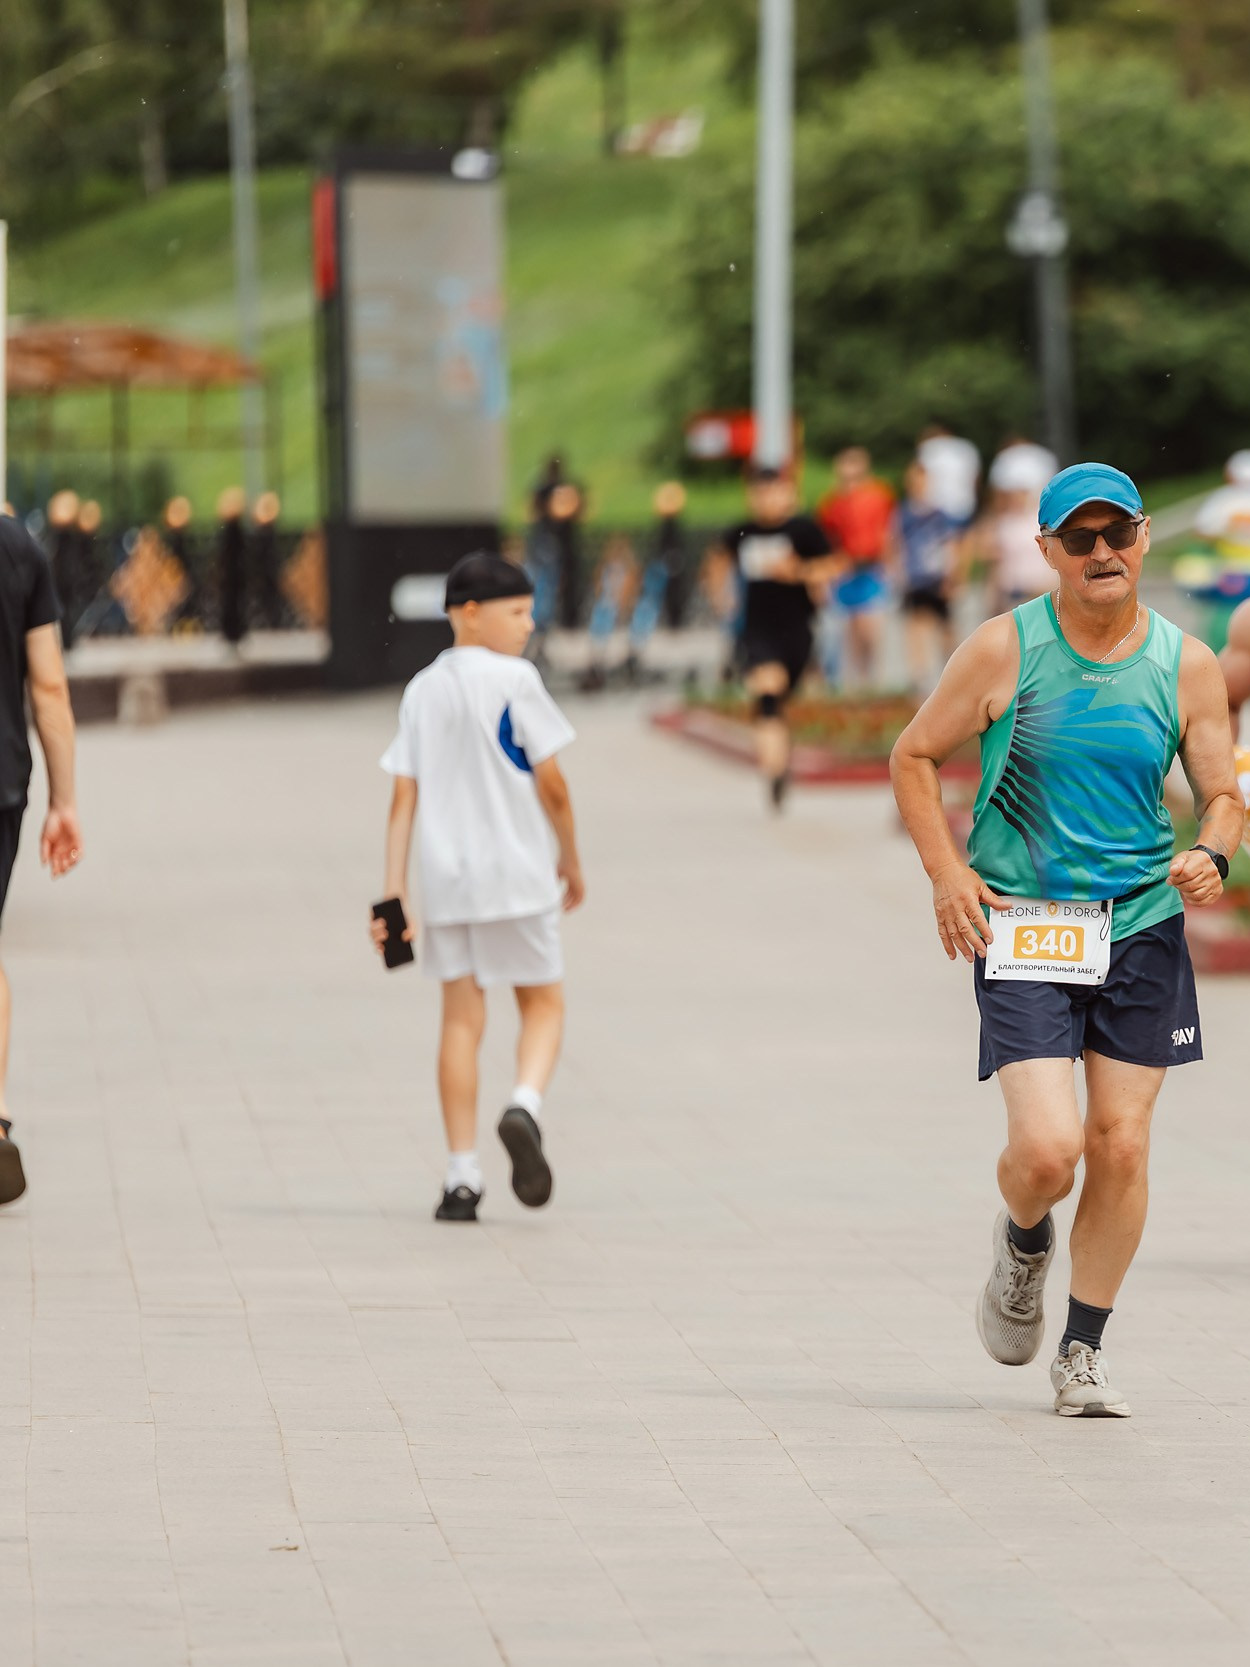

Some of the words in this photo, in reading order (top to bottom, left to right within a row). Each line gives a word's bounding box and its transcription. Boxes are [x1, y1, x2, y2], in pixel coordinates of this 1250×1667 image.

[1082, 673, 1112, 683] CRAFT
[1000, 906, 1041, 918] LEONE
[1063, 906, 1101, 919] D'ORO
[1020, 929, 1077, 957] 340
[998, 964, 1076, 973] БЛАГОТВОРИТЕЛЬНЫЙ
